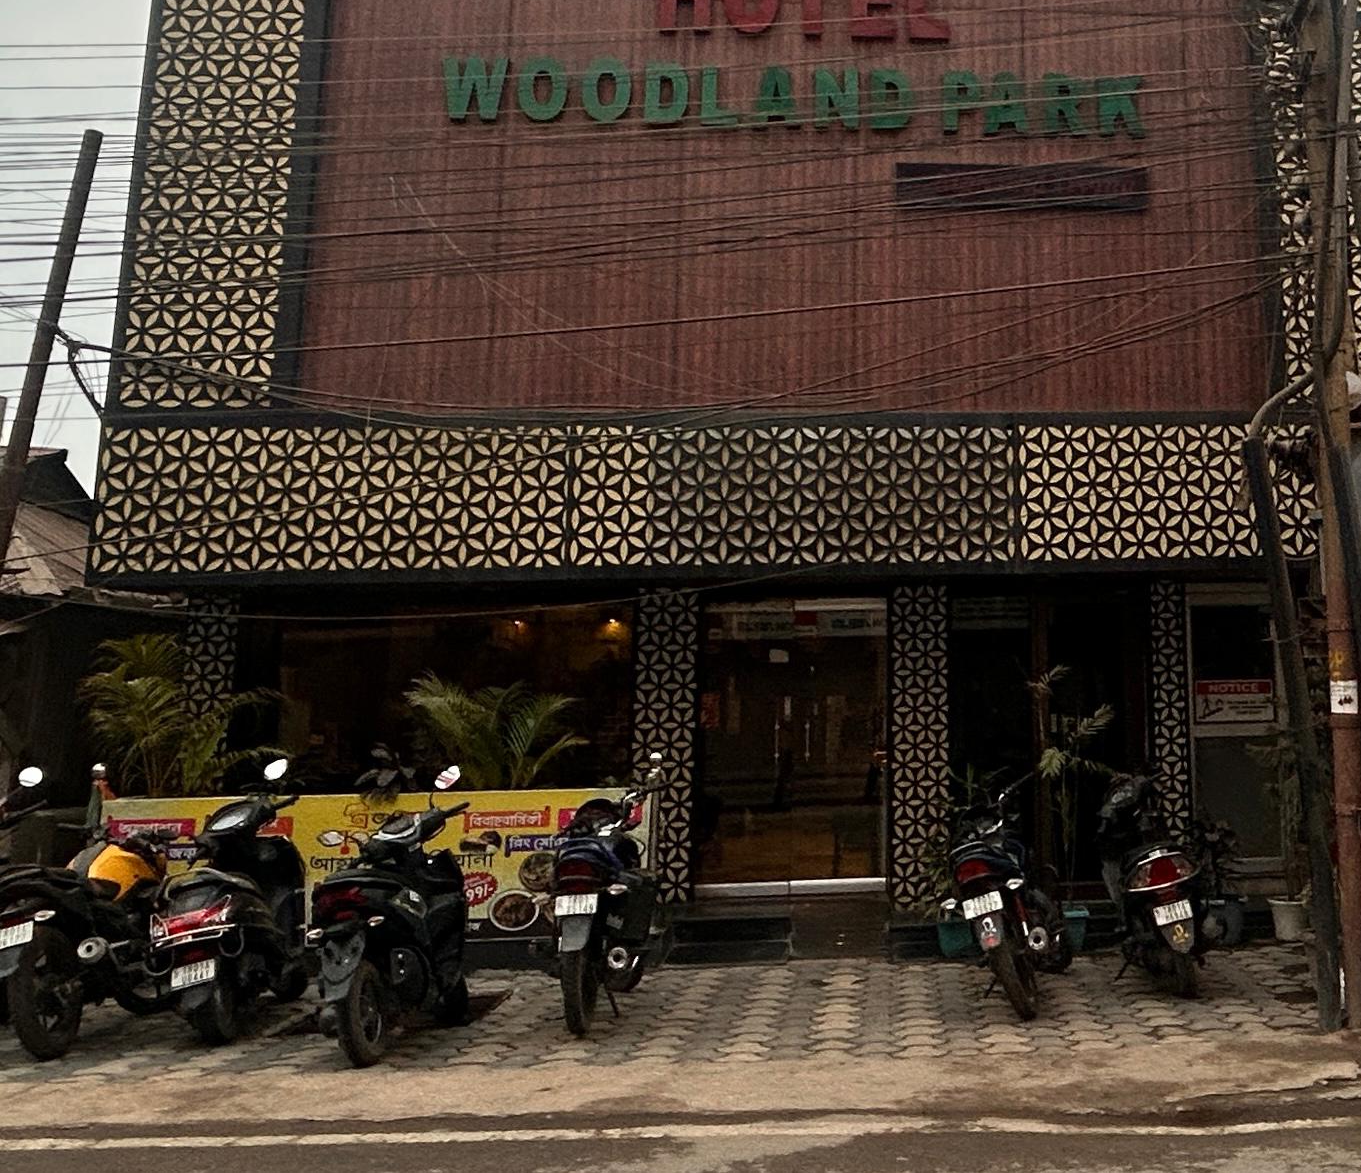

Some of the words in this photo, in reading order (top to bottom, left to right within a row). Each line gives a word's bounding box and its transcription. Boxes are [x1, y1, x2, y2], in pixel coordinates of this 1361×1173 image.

[443, 56, 912, 132] WOODLAND
[941, 69, 1149, 140] PARK
[1208, 682, 1260, 693] NOTICE
